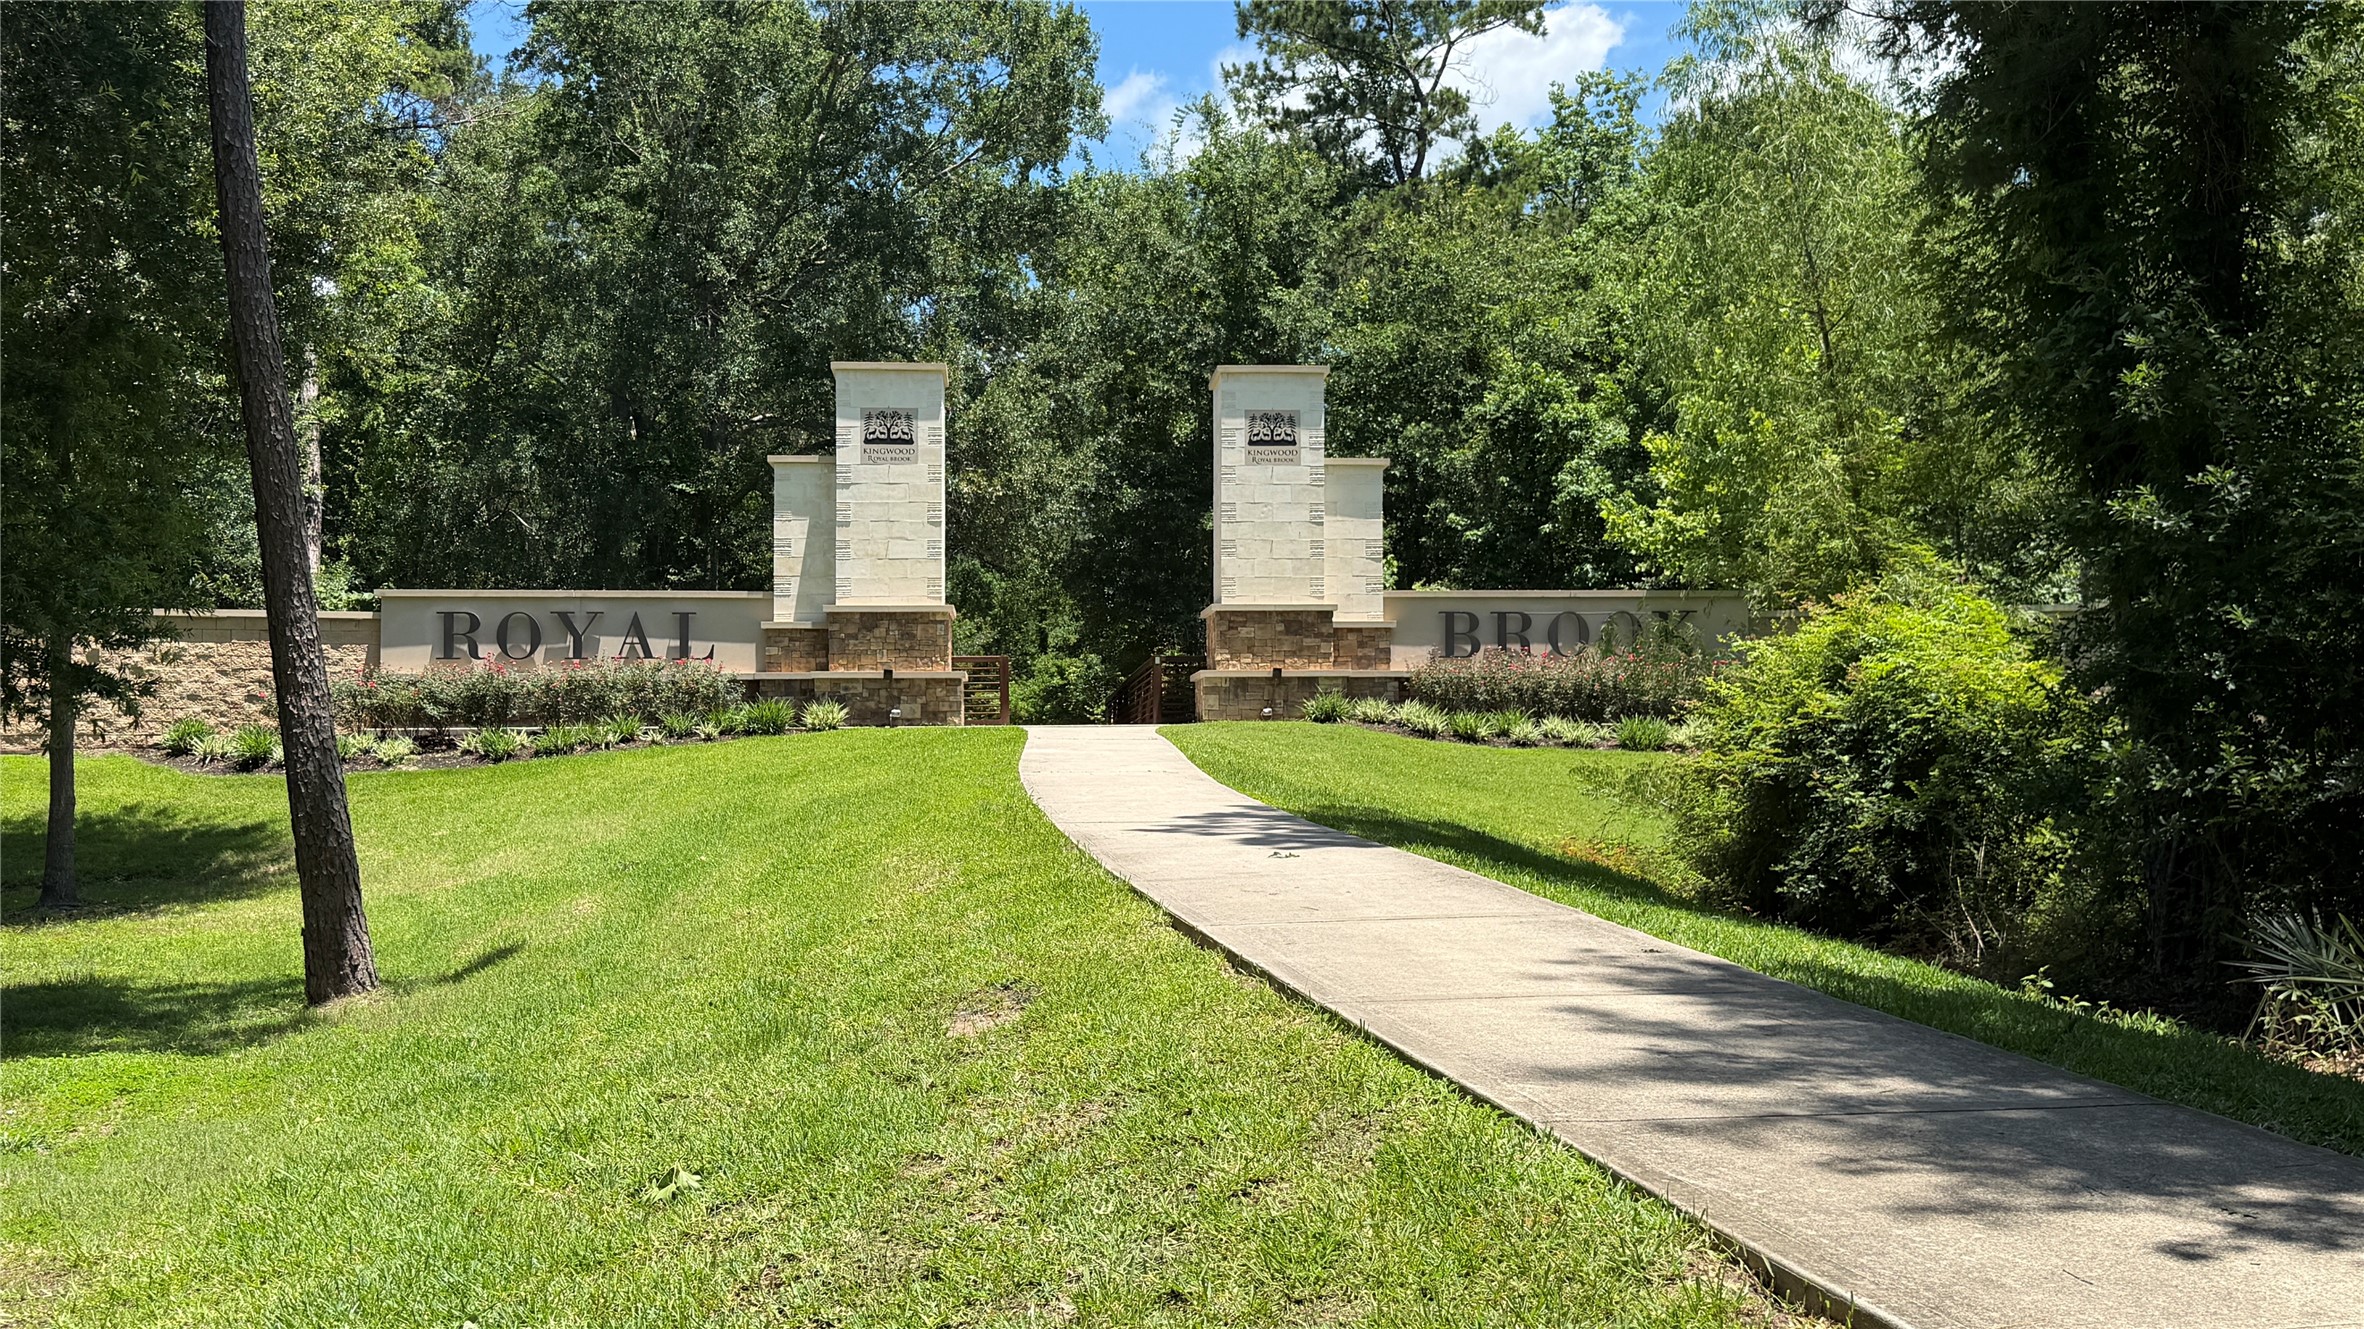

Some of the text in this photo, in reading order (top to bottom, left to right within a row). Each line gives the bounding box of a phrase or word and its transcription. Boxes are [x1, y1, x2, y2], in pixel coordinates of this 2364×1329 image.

[867, 455, 888, 463] ROYAL
[1252, 457, 1272, 465] ROYAL
[436, 611, 715, 660] ROYAL
